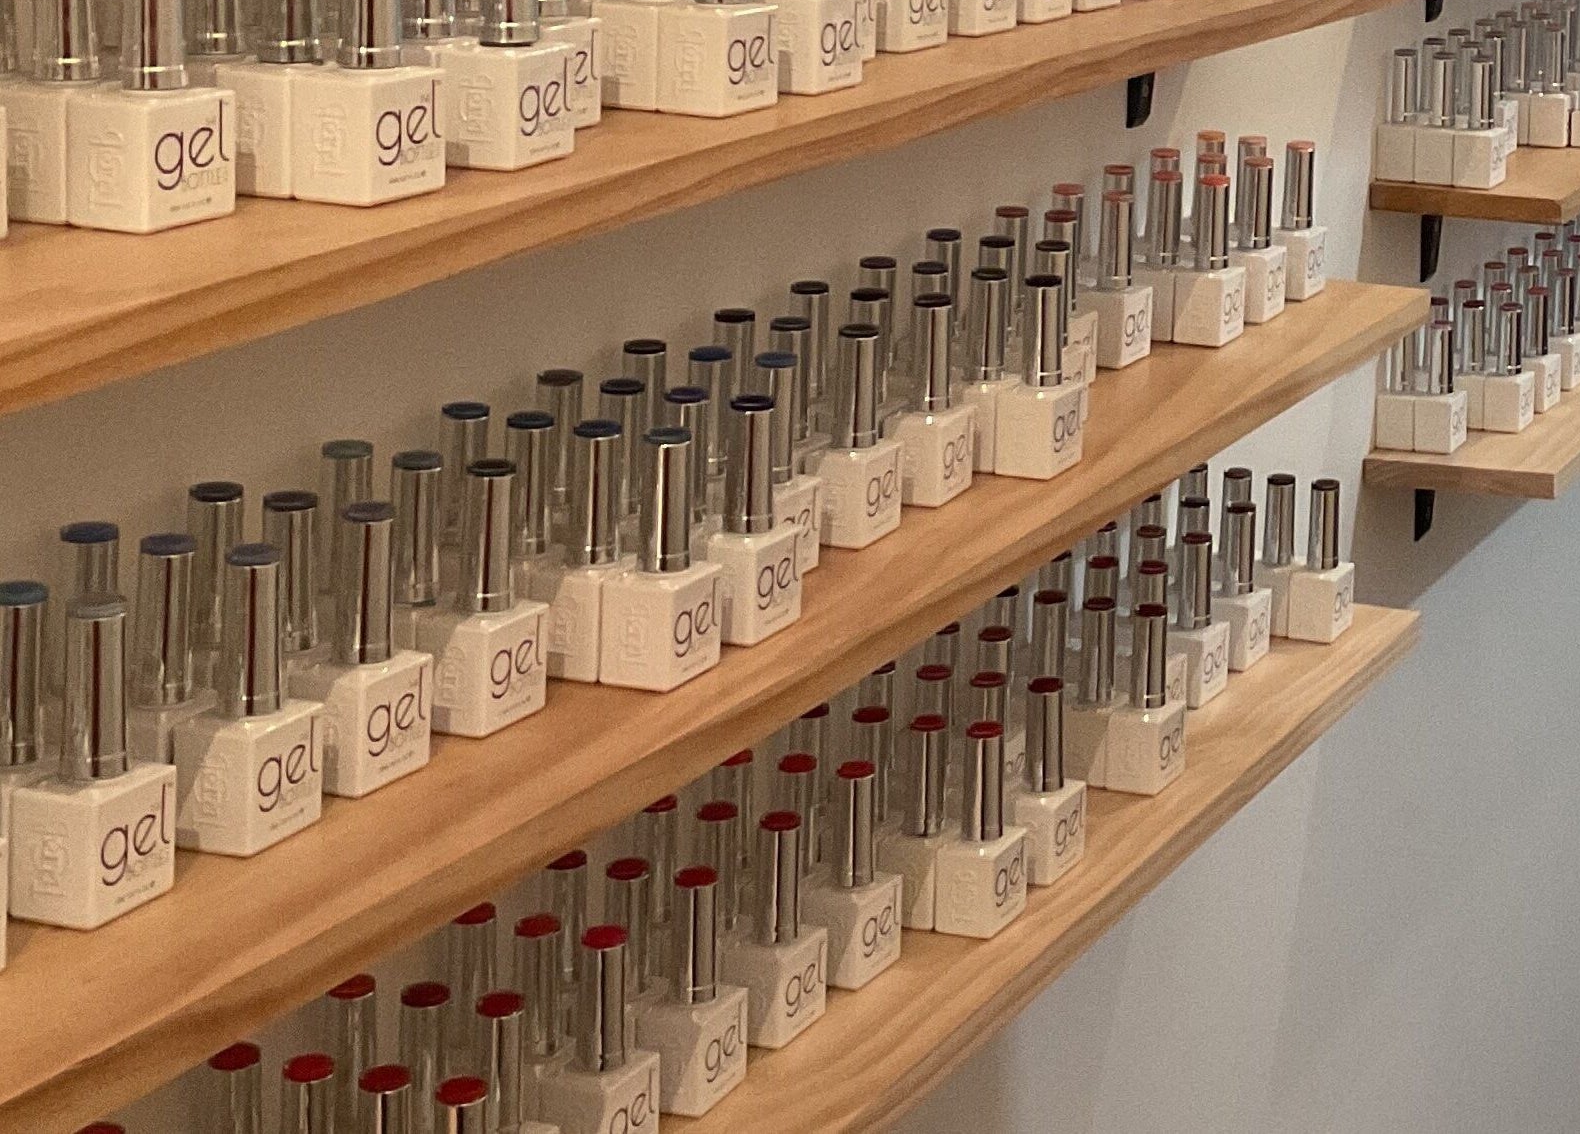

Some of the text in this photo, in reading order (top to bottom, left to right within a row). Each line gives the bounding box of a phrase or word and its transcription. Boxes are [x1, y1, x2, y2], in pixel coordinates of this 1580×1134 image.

[727, 15, 775, 85] gel
[820, 1, 861, 66] gel
[376, 79, 442, 166] gel
[519, 57, 572, 136] gel
[155, 99, 229, 190] gel
[1124, 292, 1152, 346] gel
[1222, 272, 1244, 324] gel
[943, 415, 972, 479] gel
[1053, 387, 1082, 453] gel
[866, 447, 900, 517] gel
[757, 533, 799, 610] gel
[673, 576, 718, 658] gel
[491, 614, 543, 699] gel
[367, 665, 426, 757] gel
[258, 717, 320, 813] gel
[101, 783, 171, 887] gel
[1055, 792, 1084, 857] gel
[994, 840, 1026, 908] gel
[863, 887, 900, 958] gel
[786, 941, 826, 1017] gel
[705, 1002, 745, 1083] gel
